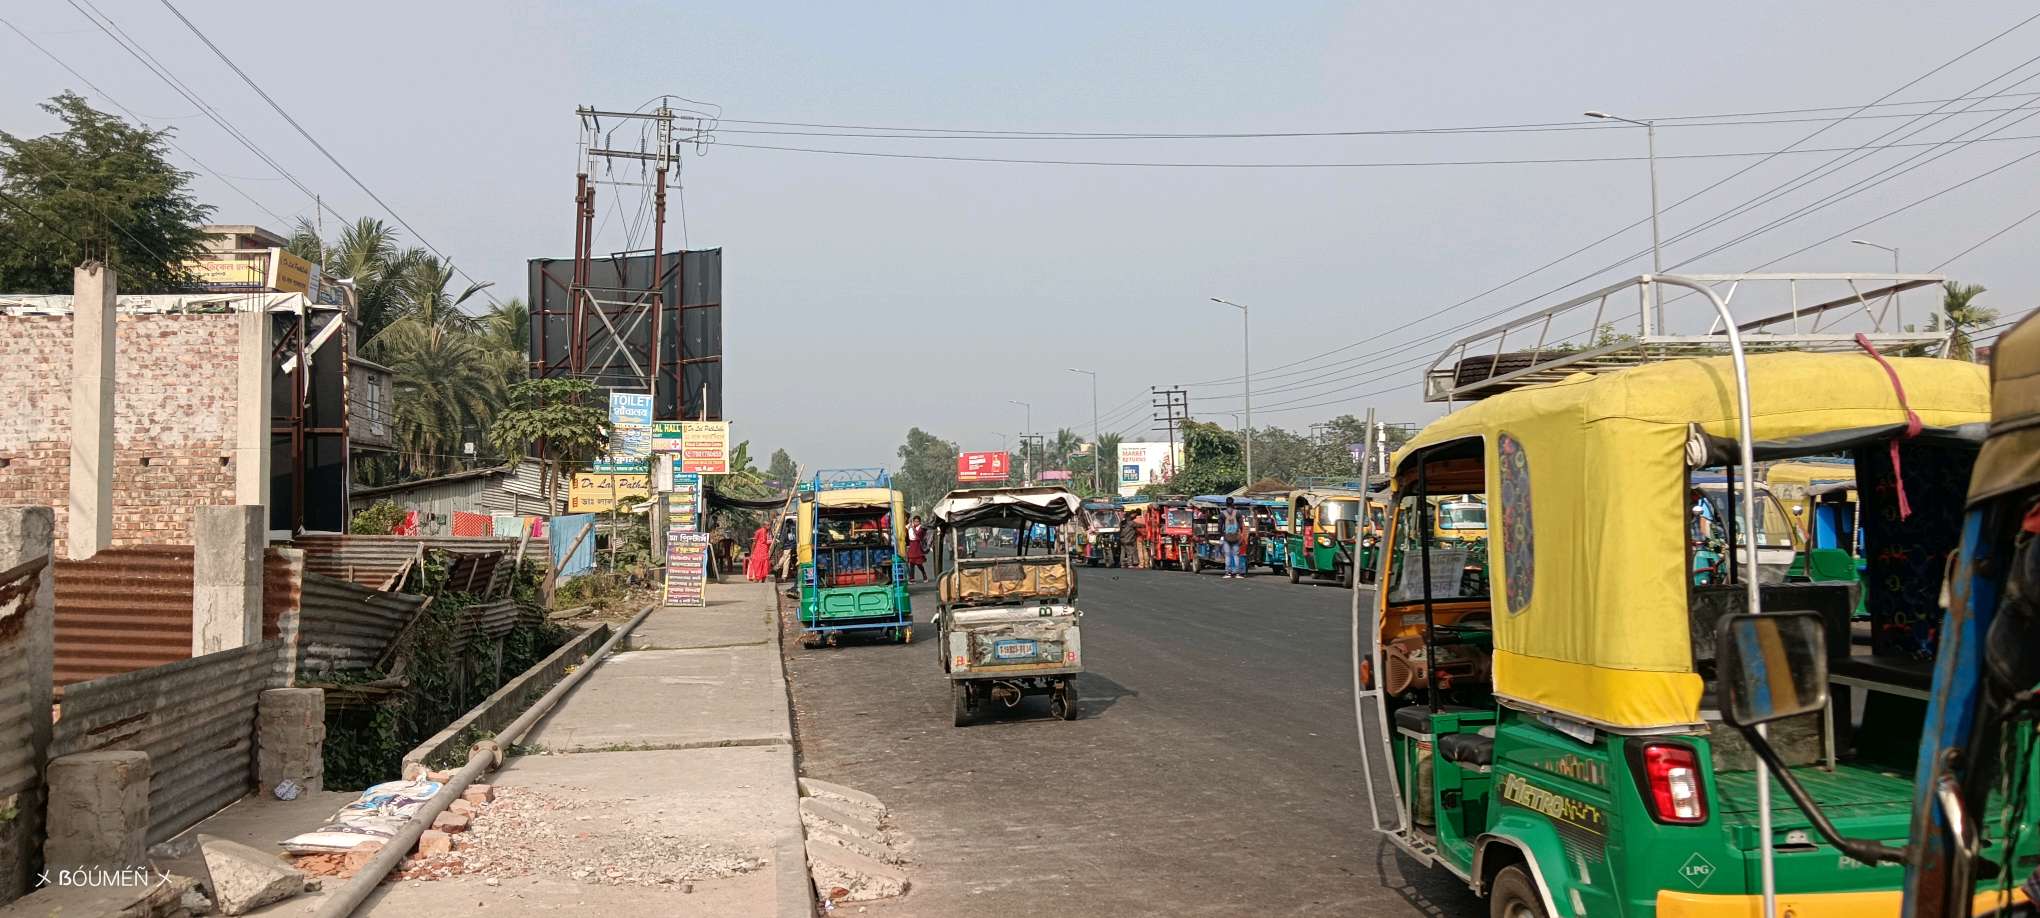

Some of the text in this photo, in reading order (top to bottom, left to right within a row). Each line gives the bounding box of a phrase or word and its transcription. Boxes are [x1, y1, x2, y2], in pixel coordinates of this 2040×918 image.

[613, 395, 650, 407] TOILET
[664, 423, 681, 433] HALL
[581, 478, 594, 488] Dr
[1503, 772, 1565, 820] METRO
[1686, 864, 1710, 876] LPG
